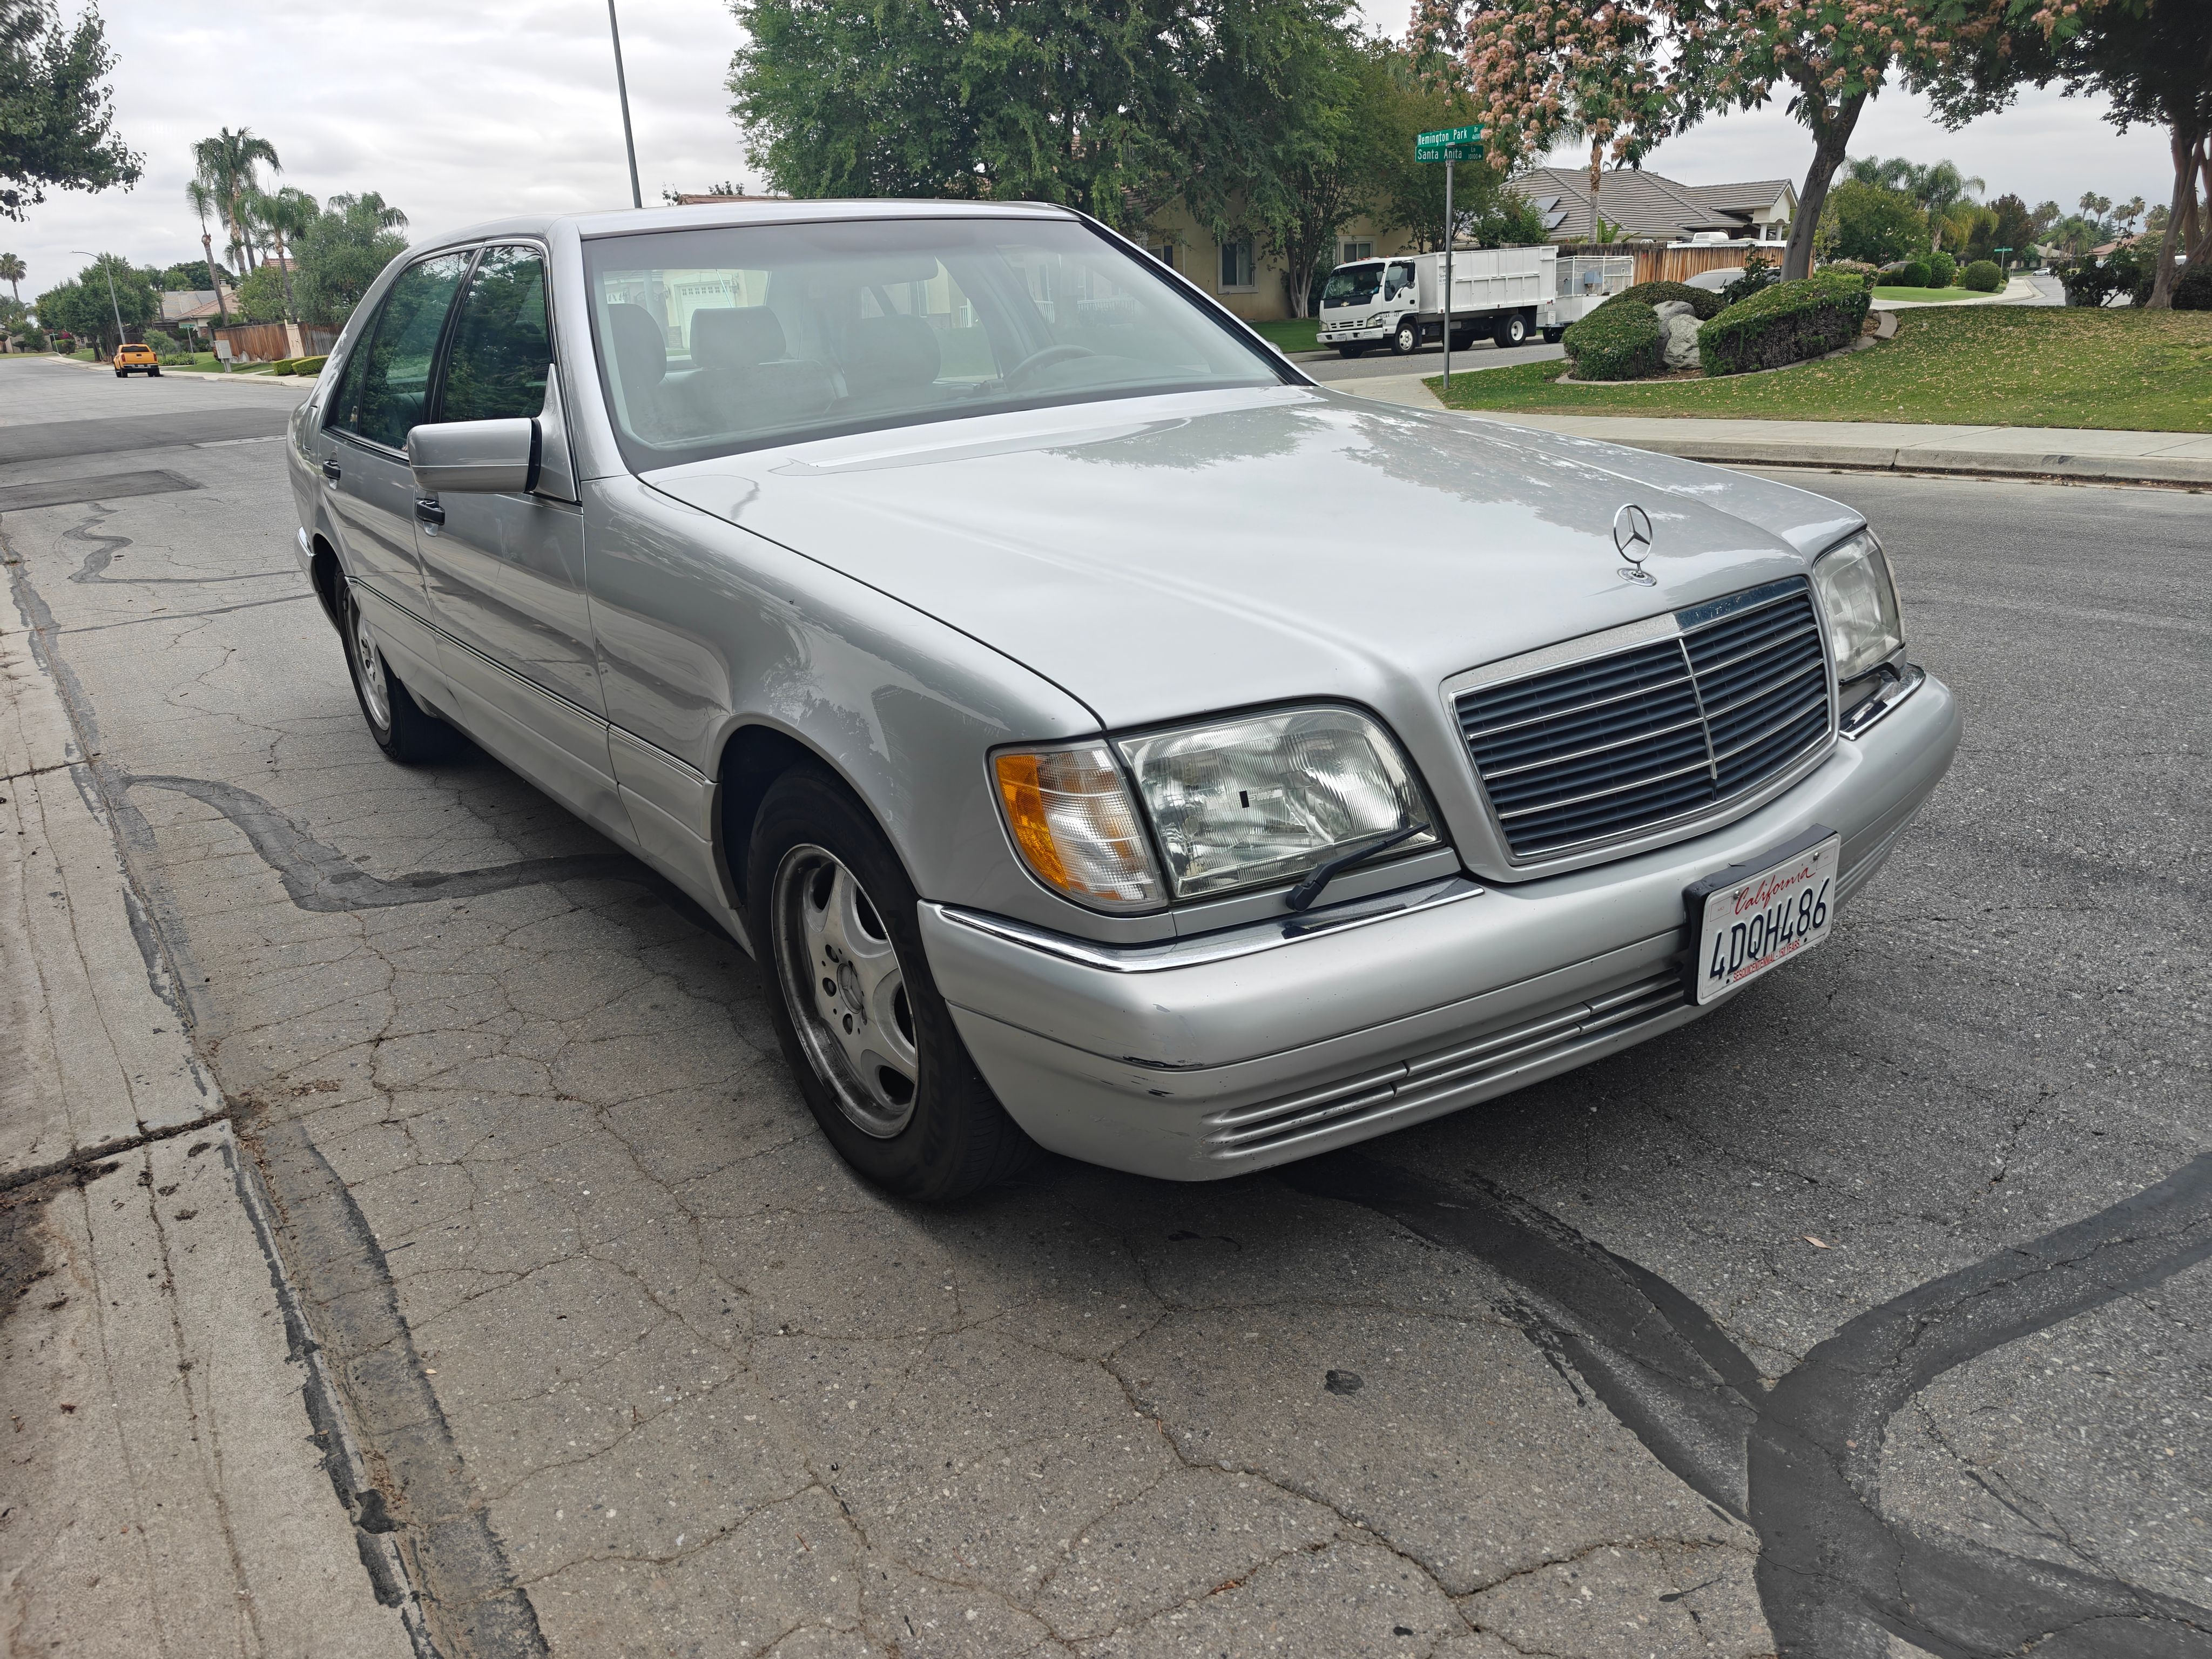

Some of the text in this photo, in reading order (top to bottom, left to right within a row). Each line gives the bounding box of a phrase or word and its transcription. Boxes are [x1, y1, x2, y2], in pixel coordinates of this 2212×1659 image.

[1418, 129, 1467, 146] Remington Park
[1418, 149, 1462, 160] Santa Anita
[1735, 864, 1816, 915] California
[1710, 878, 1830, 980] 4DQH486
